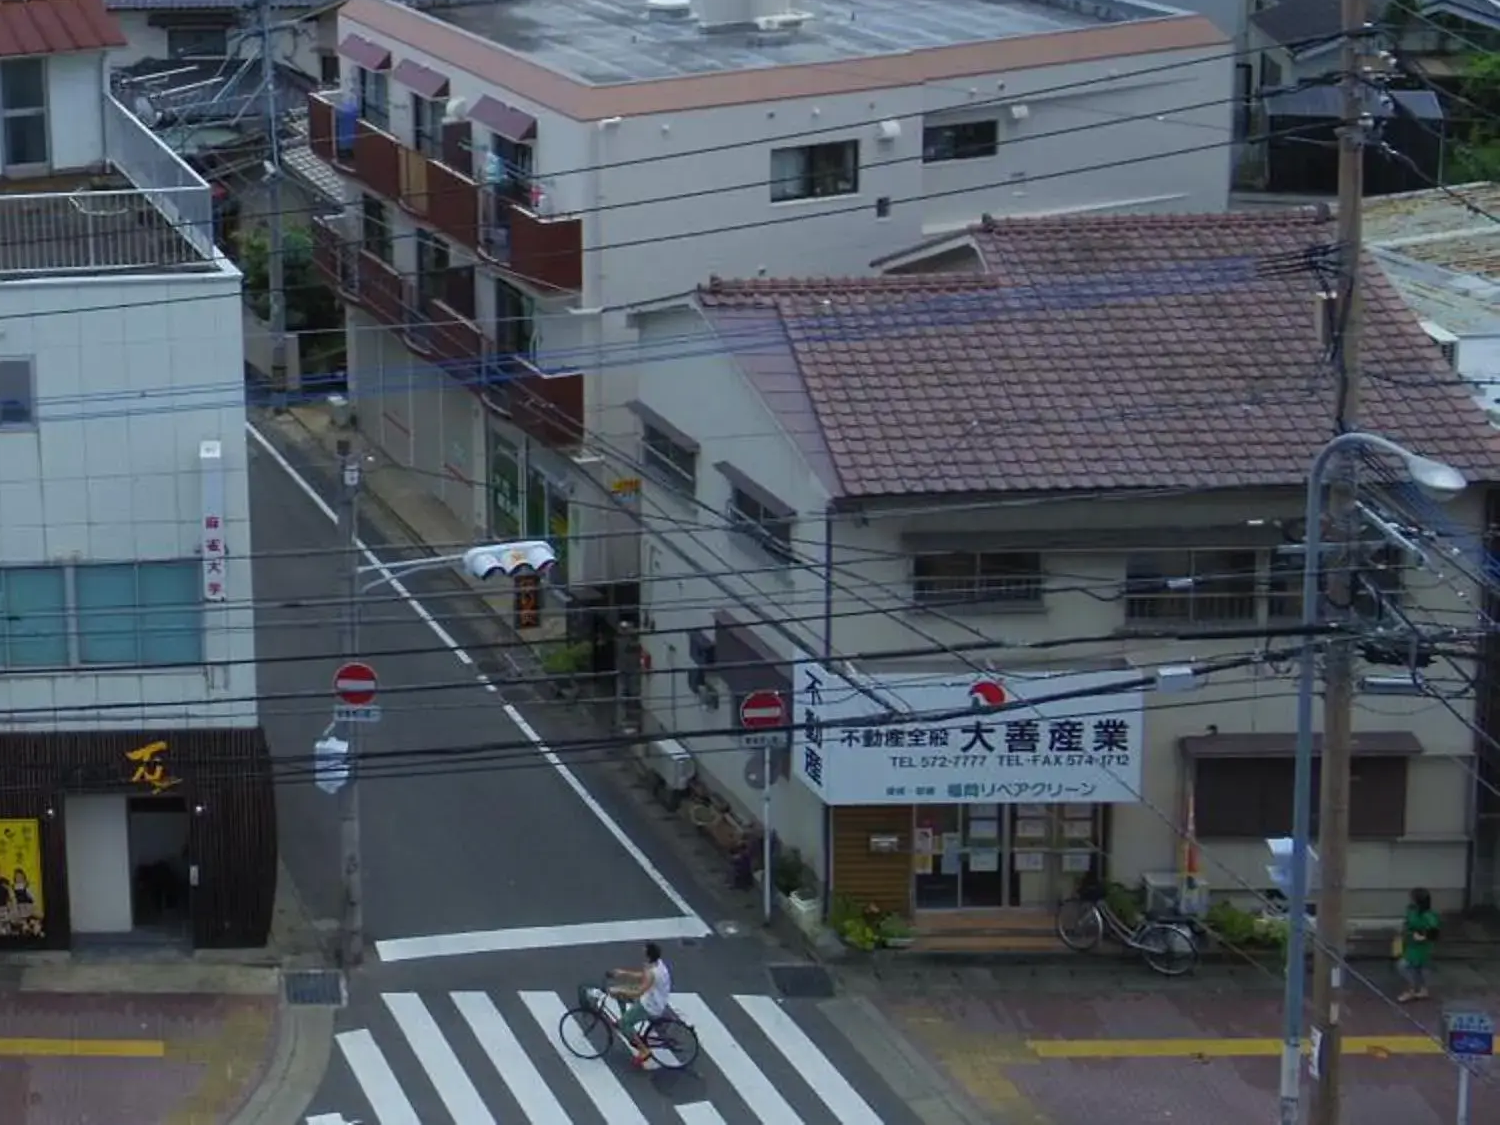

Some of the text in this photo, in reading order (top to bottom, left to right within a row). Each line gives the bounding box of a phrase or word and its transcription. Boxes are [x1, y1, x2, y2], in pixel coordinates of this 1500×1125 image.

[803, 668, 824, 788] 不動産
[839, 719, 1129, 753] 不動産全般 大善産業
[889, 755, 917, 768] TEL
[920, 755, 987, 768] 572-7777
